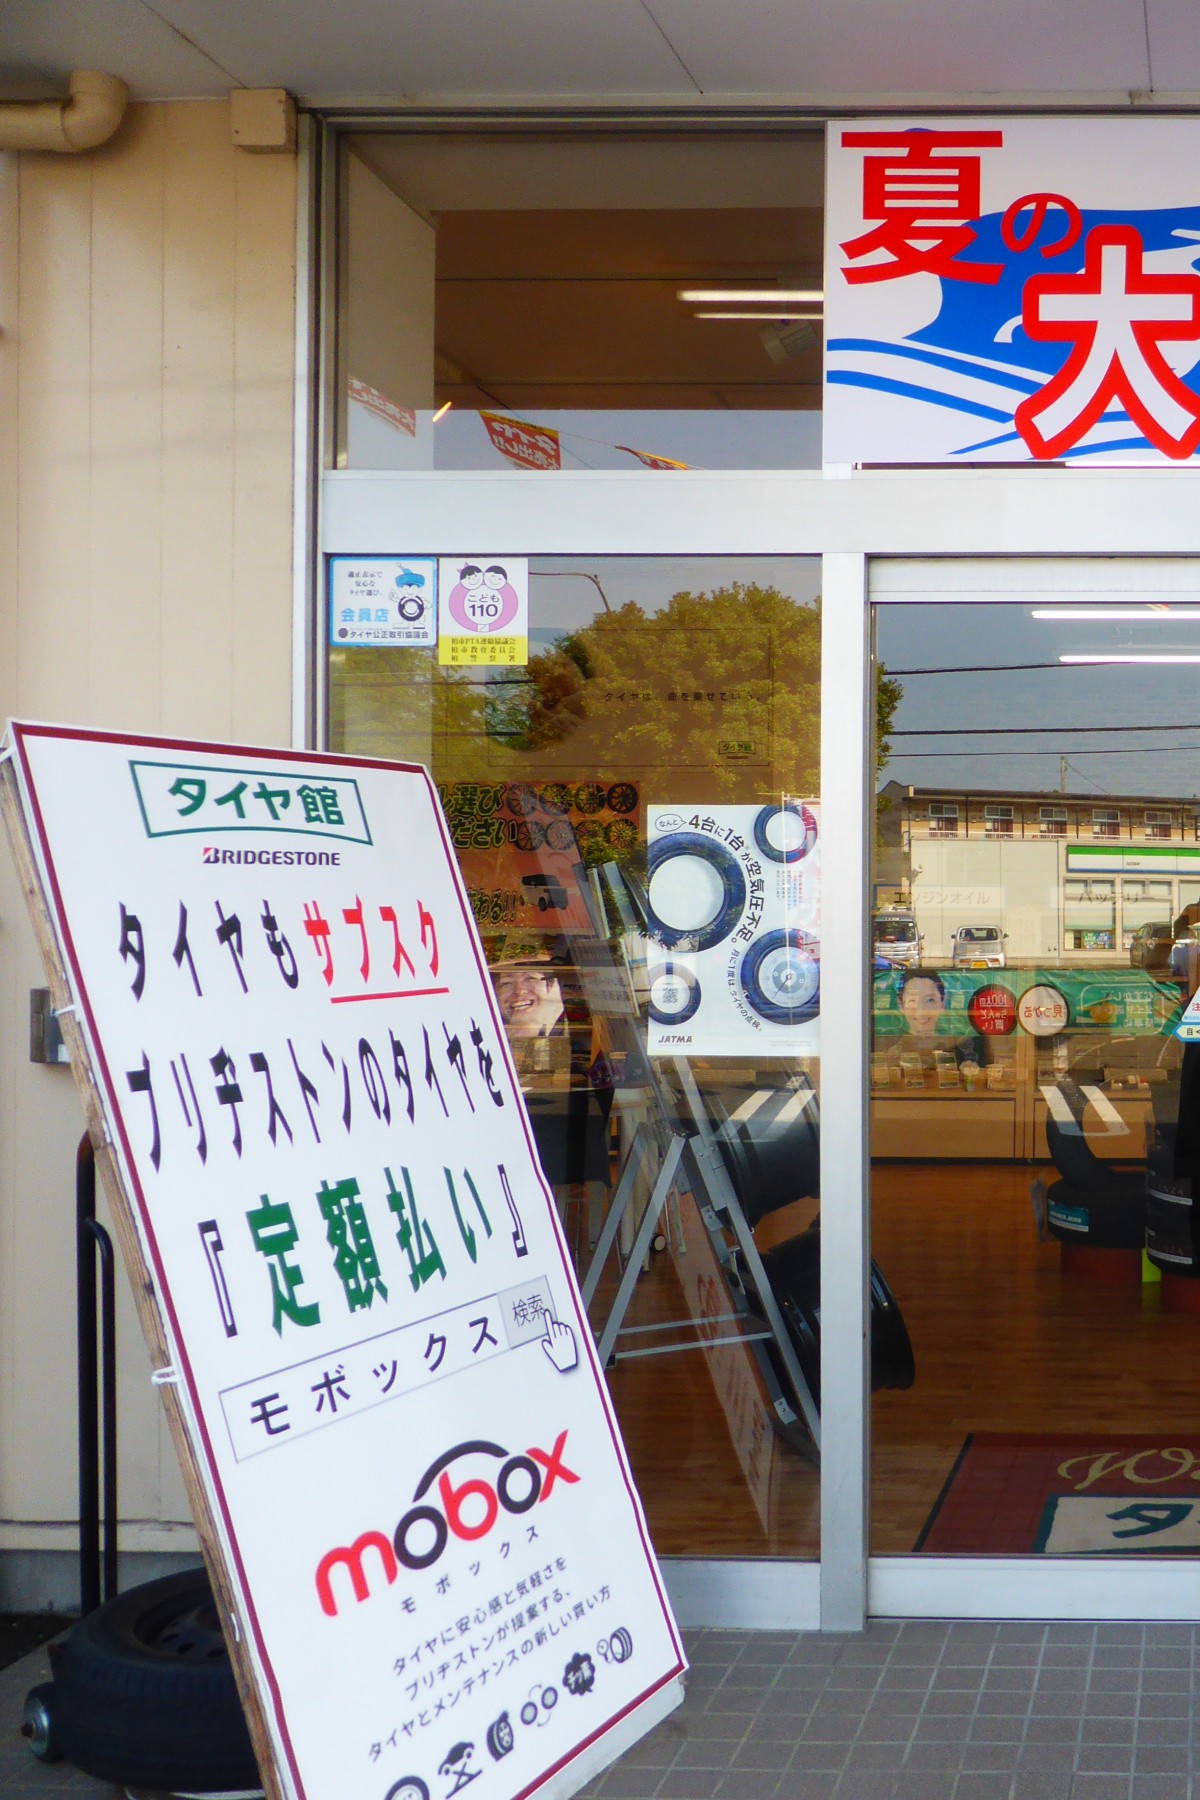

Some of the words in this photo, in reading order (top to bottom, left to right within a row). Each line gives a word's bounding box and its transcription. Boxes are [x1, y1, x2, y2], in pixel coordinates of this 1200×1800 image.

[839, 130, 1083, 286] 夏の
[340, 607, 390, 623] 会員店
[467, 594, 500, 604] こども
[468, 603, 499, 617] 110
[350, 630, 429, 640] タイヤ公正取引協議会
[168, 776, 345, 827] タイヤ館
[659, 818, 679, 828] なんと
[202, 847, 341, 867] BRIDGESTONE
[657, 1035, 693, 1044] JATMA
[511, 1292, 545, 1327] 検索
[250, 1314, 499, 1436] モボックス
[315, 1428, 581, 1618] mobox
[400, 1524, 540, 1614] モボックス
[392, 1555, 568, 1677] タイヤに安心感と気軽さを
[368, 1584, 612, 1763] タイヤとメンテナンスの新しい買い方
